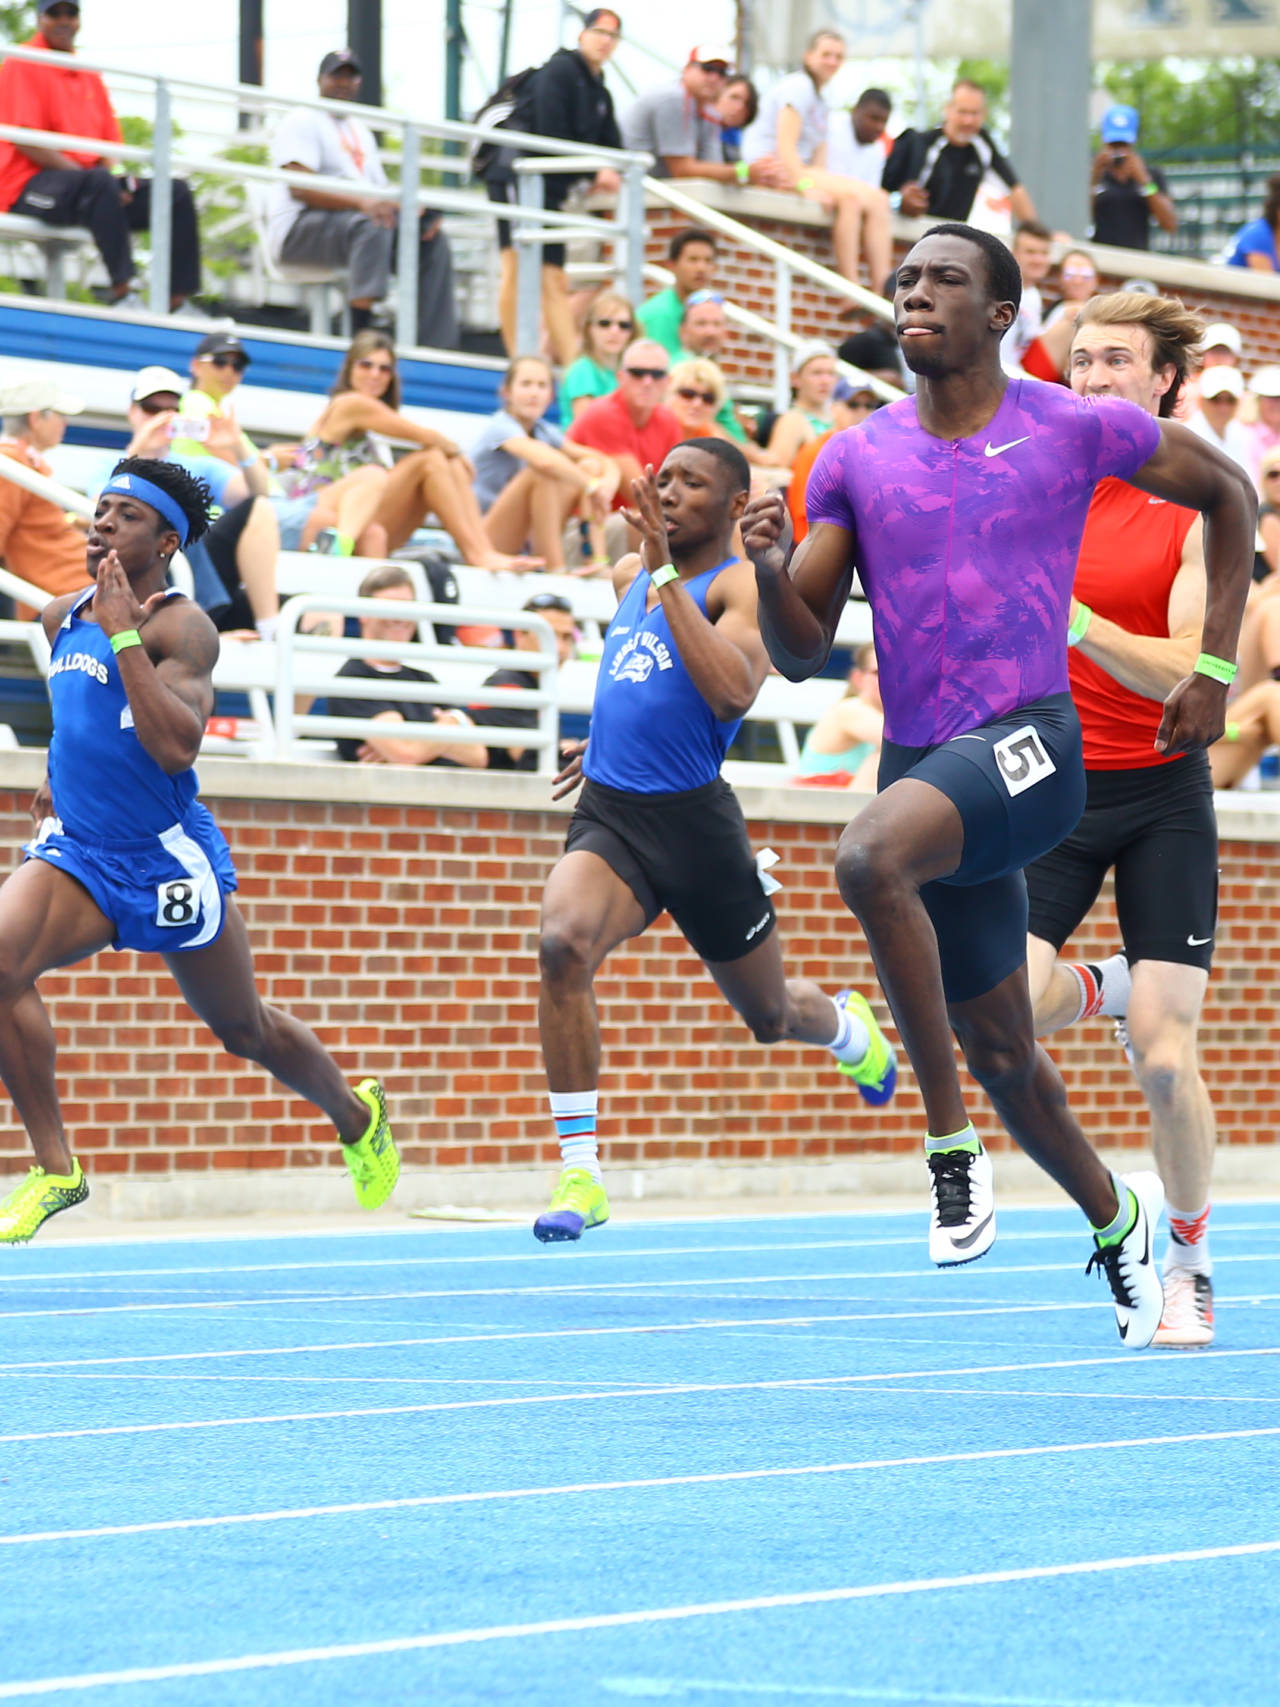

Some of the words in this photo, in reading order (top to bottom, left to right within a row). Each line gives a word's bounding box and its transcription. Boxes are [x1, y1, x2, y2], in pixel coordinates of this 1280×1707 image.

[641, 631, 673, 672] WILSON
[997, 735, 1046, 782] 5
[163, 883, 193, 923] 8
